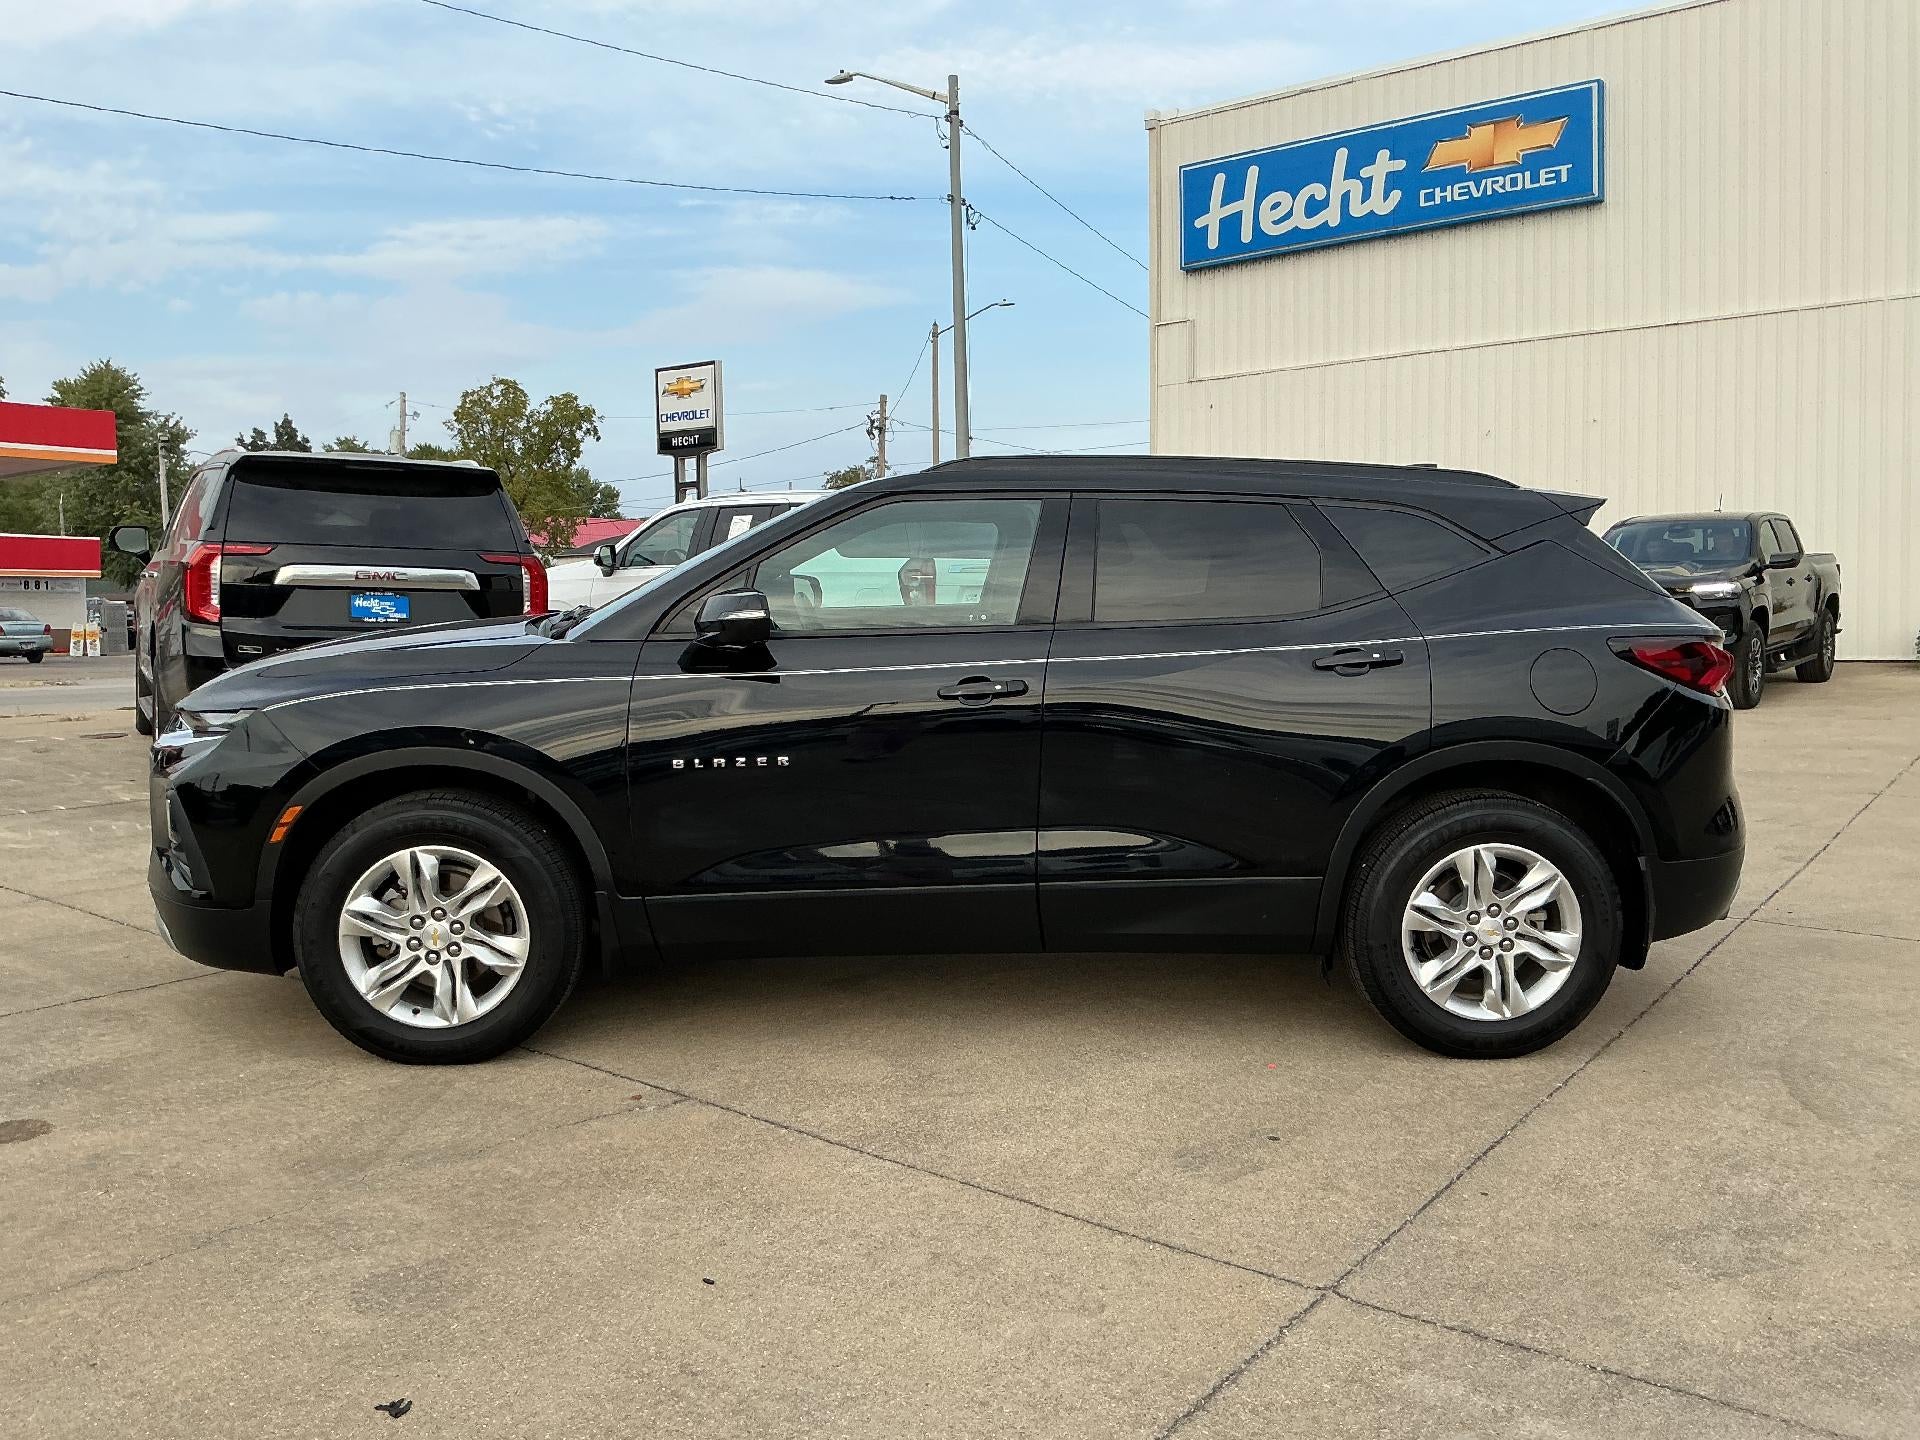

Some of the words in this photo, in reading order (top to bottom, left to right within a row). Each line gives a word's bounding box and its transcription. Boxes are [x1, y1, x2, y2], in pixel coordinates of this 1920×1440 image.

[1419, 164, 1572, 207] CHEVROLET
[1194, 147, 1406, 250] Hecht
[660, 409, 710, 423] CHEVROLET
[671, 434, 700, 447] HECHT
[355, 570, 409, 581] GMC
[354, 597, 380, 608] Hecht
[672, 756, 790, 769] BLAZER
